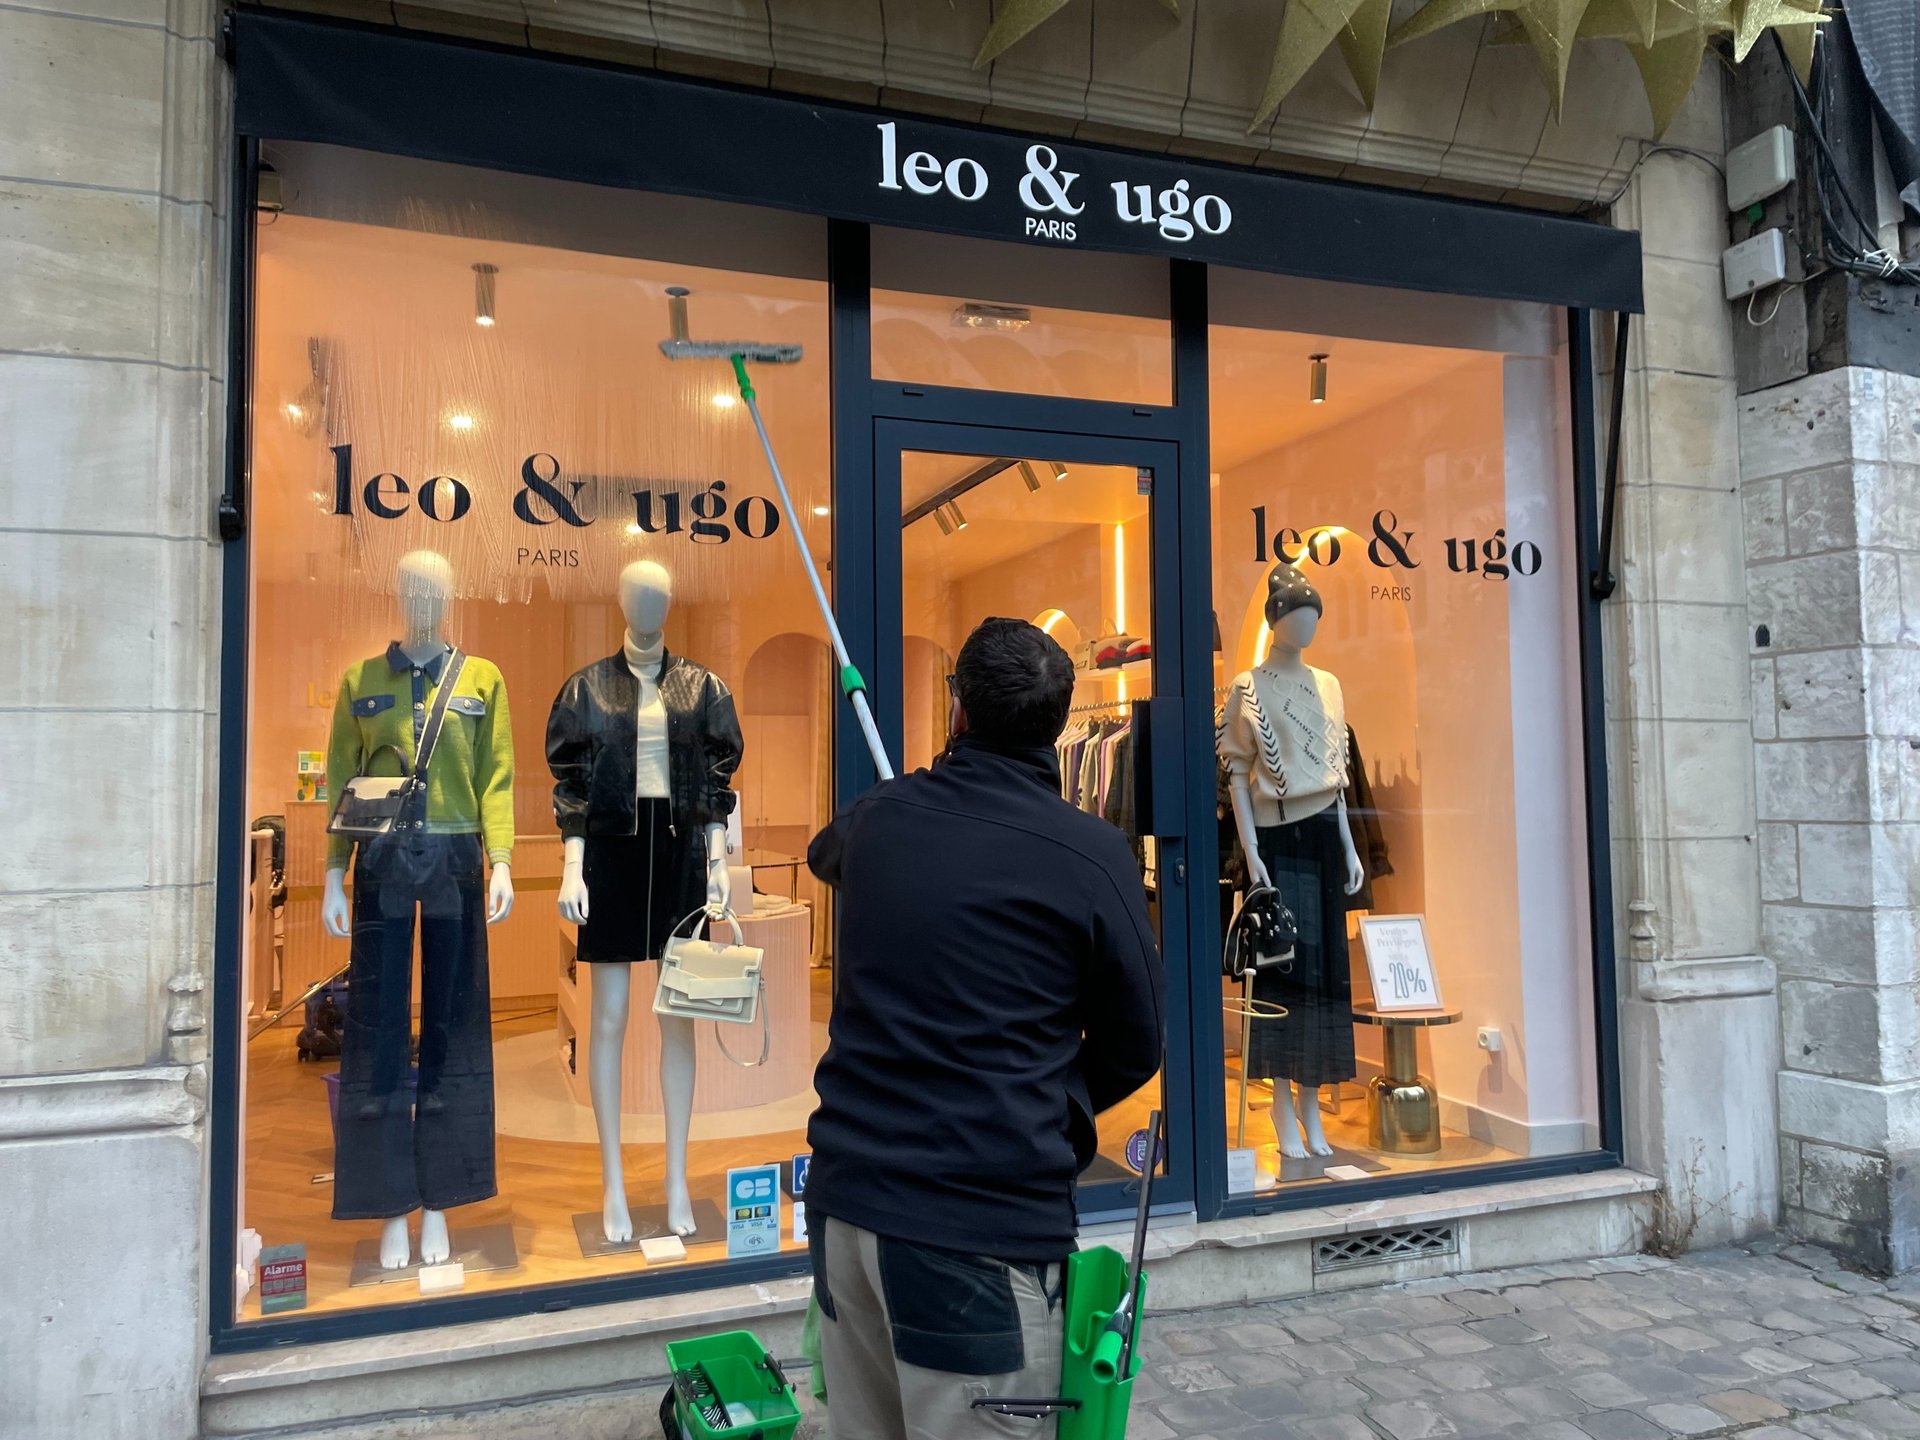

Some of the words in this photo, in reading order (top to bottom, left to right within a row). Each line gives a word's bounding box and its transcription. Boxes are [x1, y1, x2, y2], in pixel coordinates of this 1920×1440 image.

[877, 121, 989, 201] leo
[1018, 144, 1086, 216] &
[1110, 178, 1232, 242] ugo
[1024, 217, 1078, 242] PARIS
[329, 443, 472, 523] leo
[512, 452, 596, 528] &
[631, 479, 780, 545] ugo
[1250, 505, 1342, 567] leo
[1367, 509, 1422, 569] &
[1443, 528, 1542, 581] ugo
[516, 547, 580, 568] PARIS
[1371, 585, 1412, 602] PARIS
[307, 681, 332, 709] le
[735, 1177, 771, 1199] CB
[264, 1263, 303, 1277] Alarme
